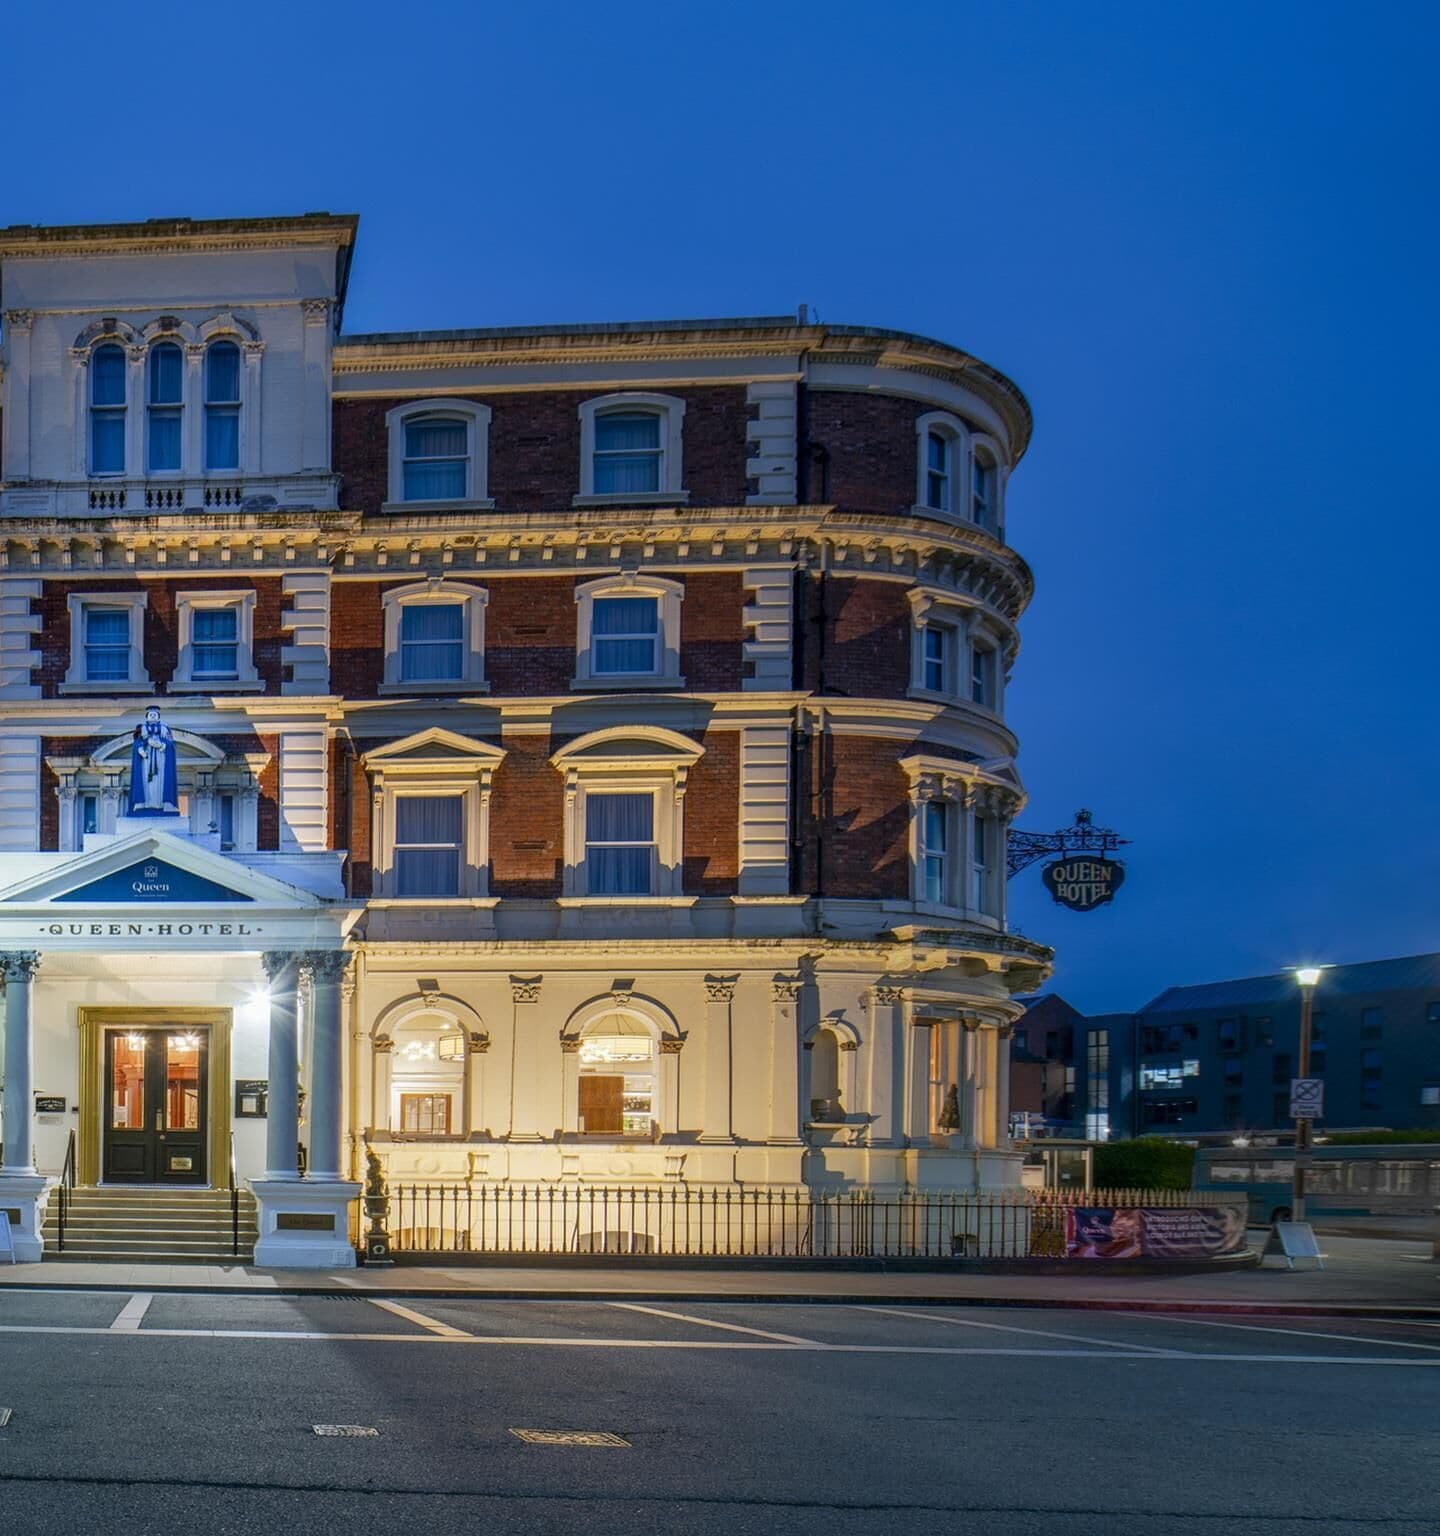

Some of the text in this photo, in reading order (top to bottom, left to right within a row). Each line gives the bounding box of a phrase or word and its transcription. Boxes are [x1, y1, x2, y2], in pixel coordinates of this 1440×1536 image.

[1053, 862, 1112, 882] QUEEN
[132, 881, 170, 893] Queen
[1057, 883, 1110, 905] HOTEL
[49, 924, 251, 936] QUEEN HOTEL
